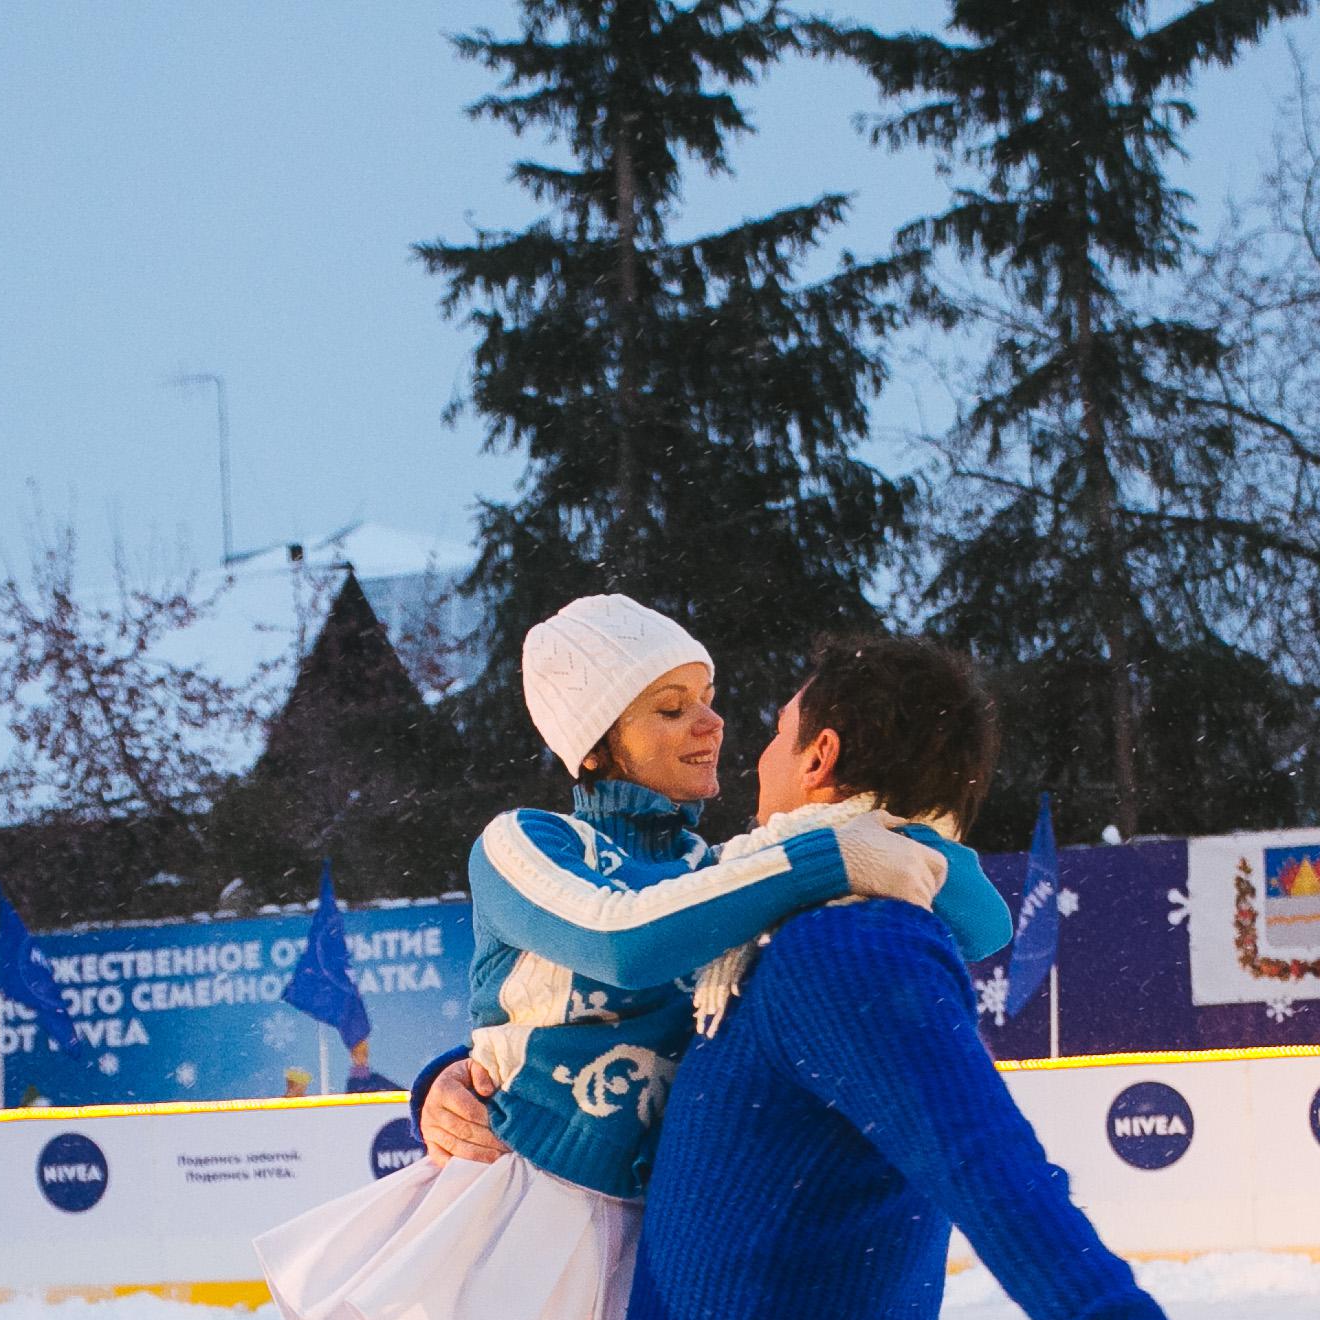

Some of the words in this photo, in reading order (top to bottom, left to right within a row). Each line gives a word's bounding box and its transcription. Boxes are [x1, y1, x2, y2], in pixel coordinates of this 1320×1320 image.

[270, 927, 442, 968] ОЫТИЕ
[1, 984, 123, 1021] ОГО
[131, 971, 293, 1012] СЕМЕЙНОГ
[48, 1017, 149, 1050] VEA
[1114, 1114, 1187, 1137] NIVEA
[377, 1148, 425, 1169] NIV
[43, 1162, 103, 1184] NIVEA
